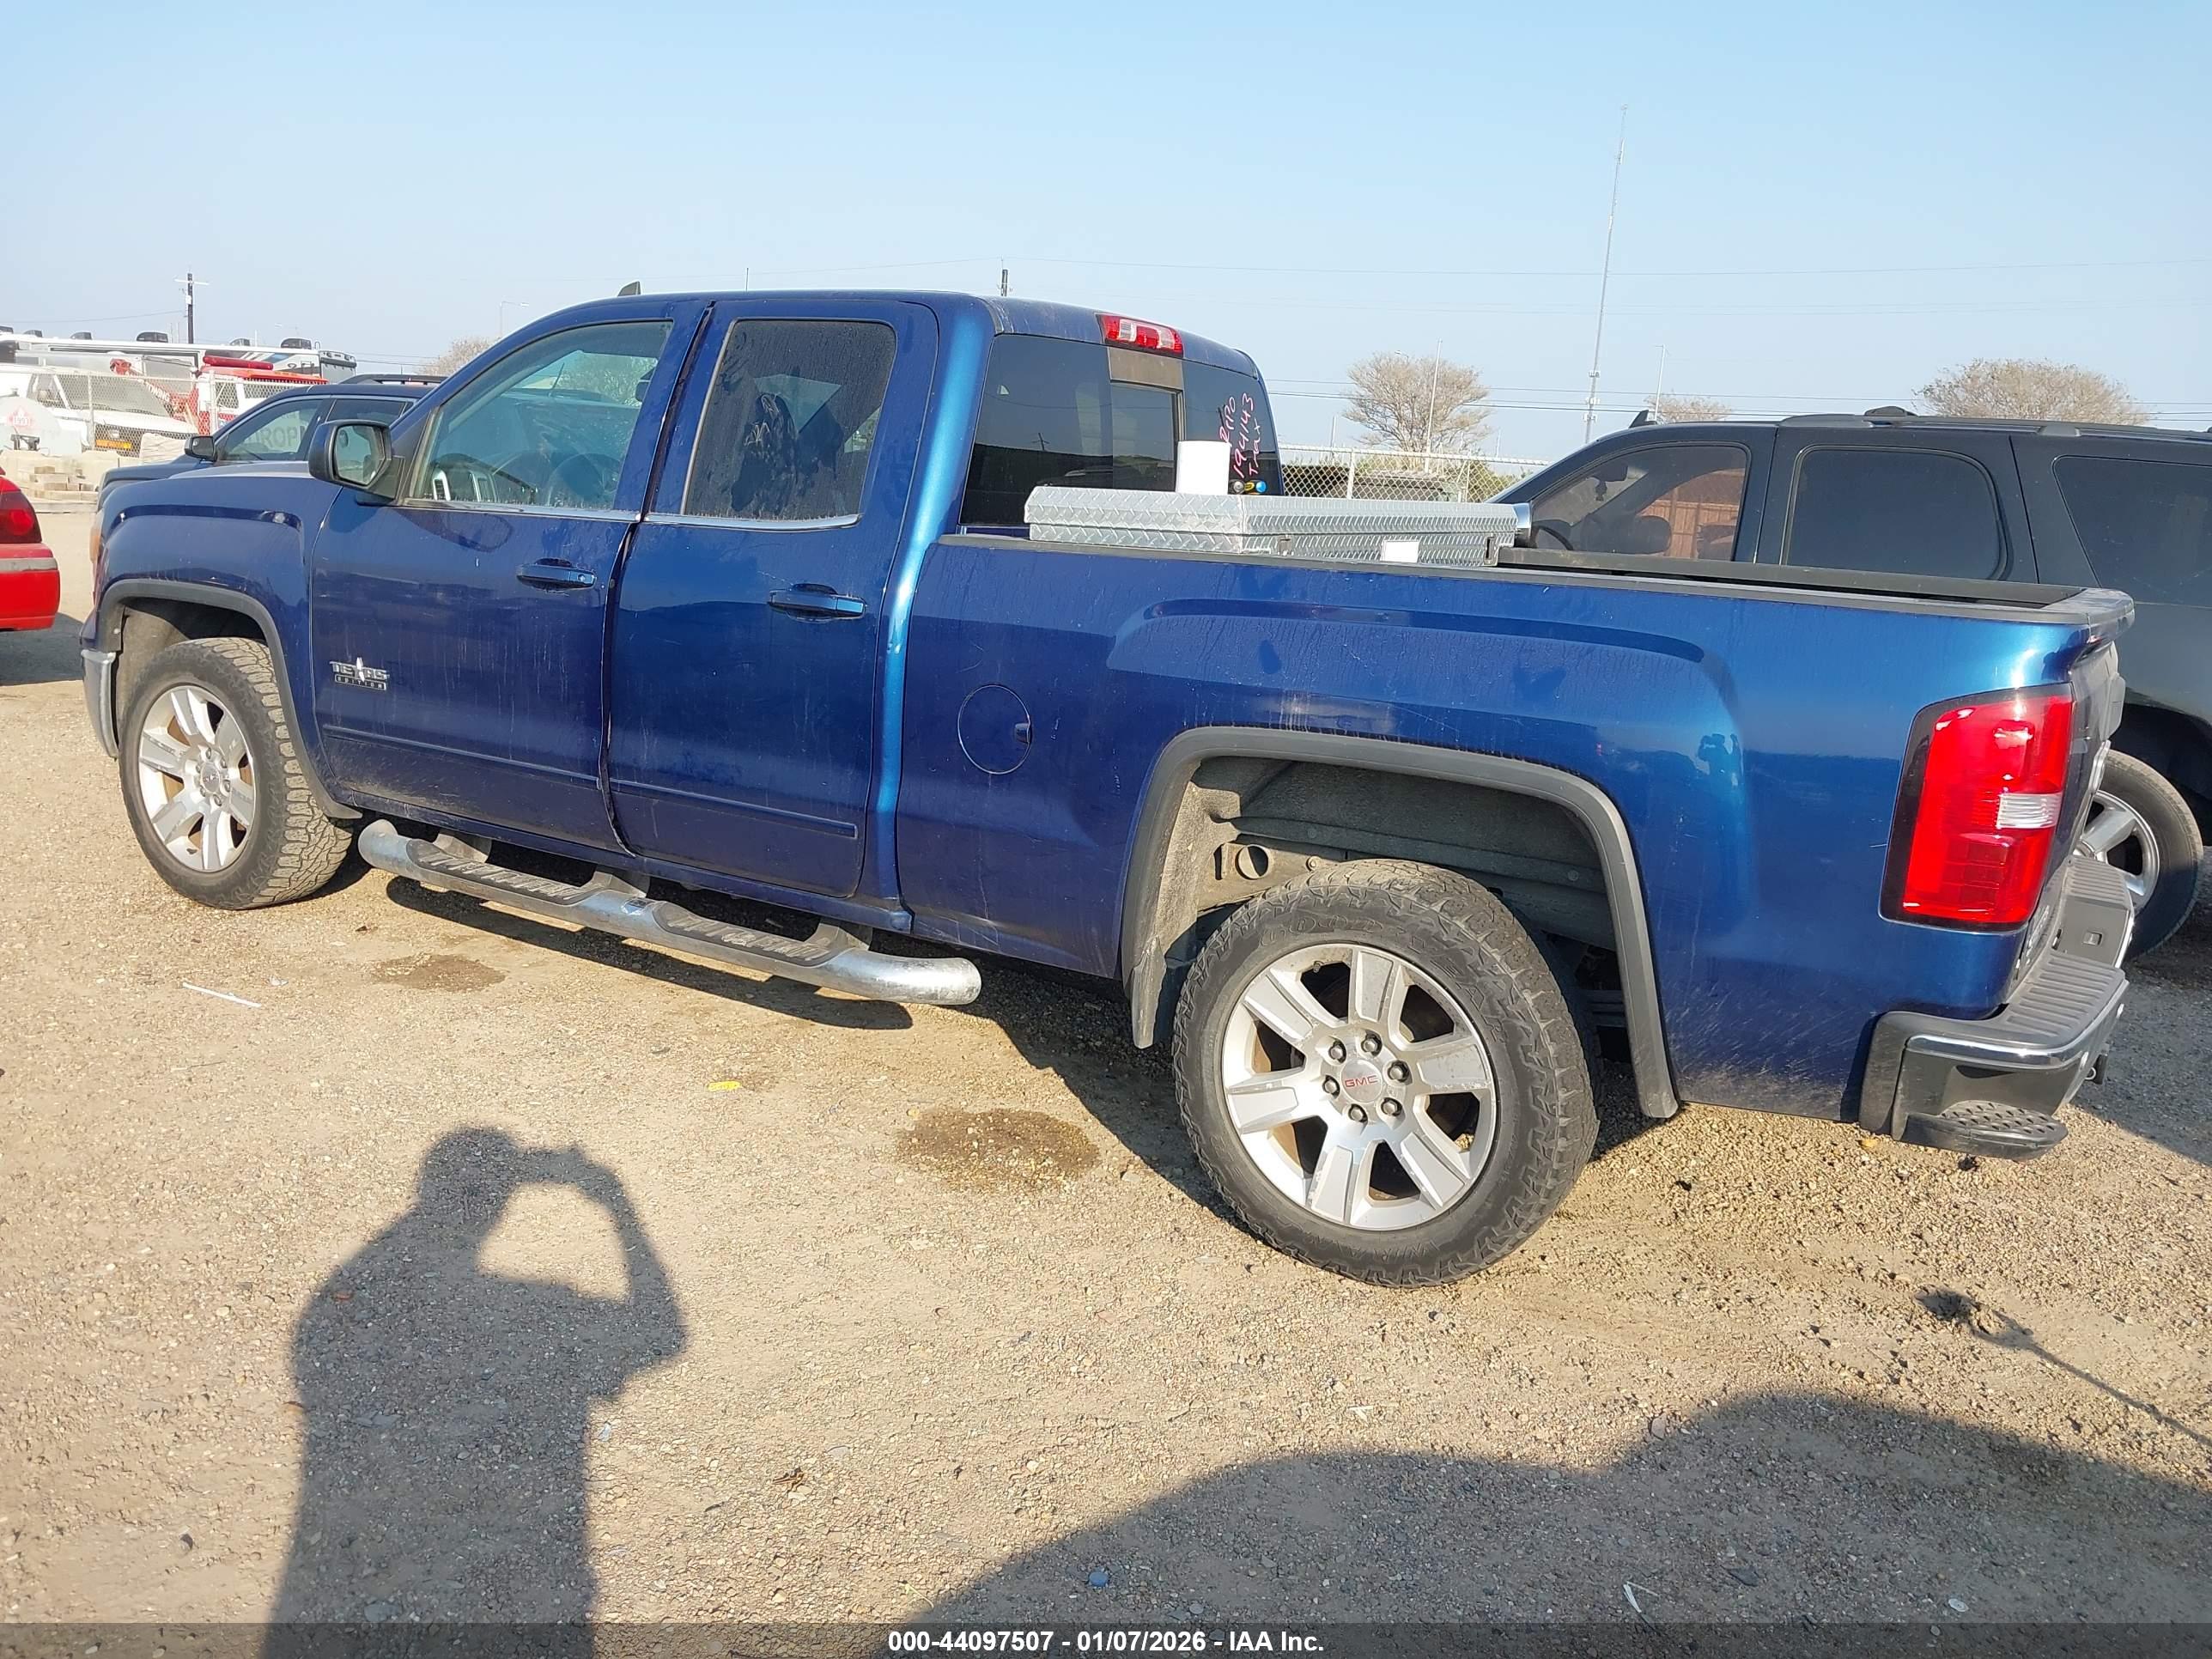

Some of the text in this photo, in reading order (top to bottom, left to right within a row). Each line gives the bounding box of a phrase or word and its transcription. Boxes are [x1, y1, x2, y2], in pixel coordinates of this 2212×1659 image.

[1233, 392, 1254, 479] 194143
[337, 675, 384, 690] EDITION
[1345, 1074, 1378, 1087] GMC
